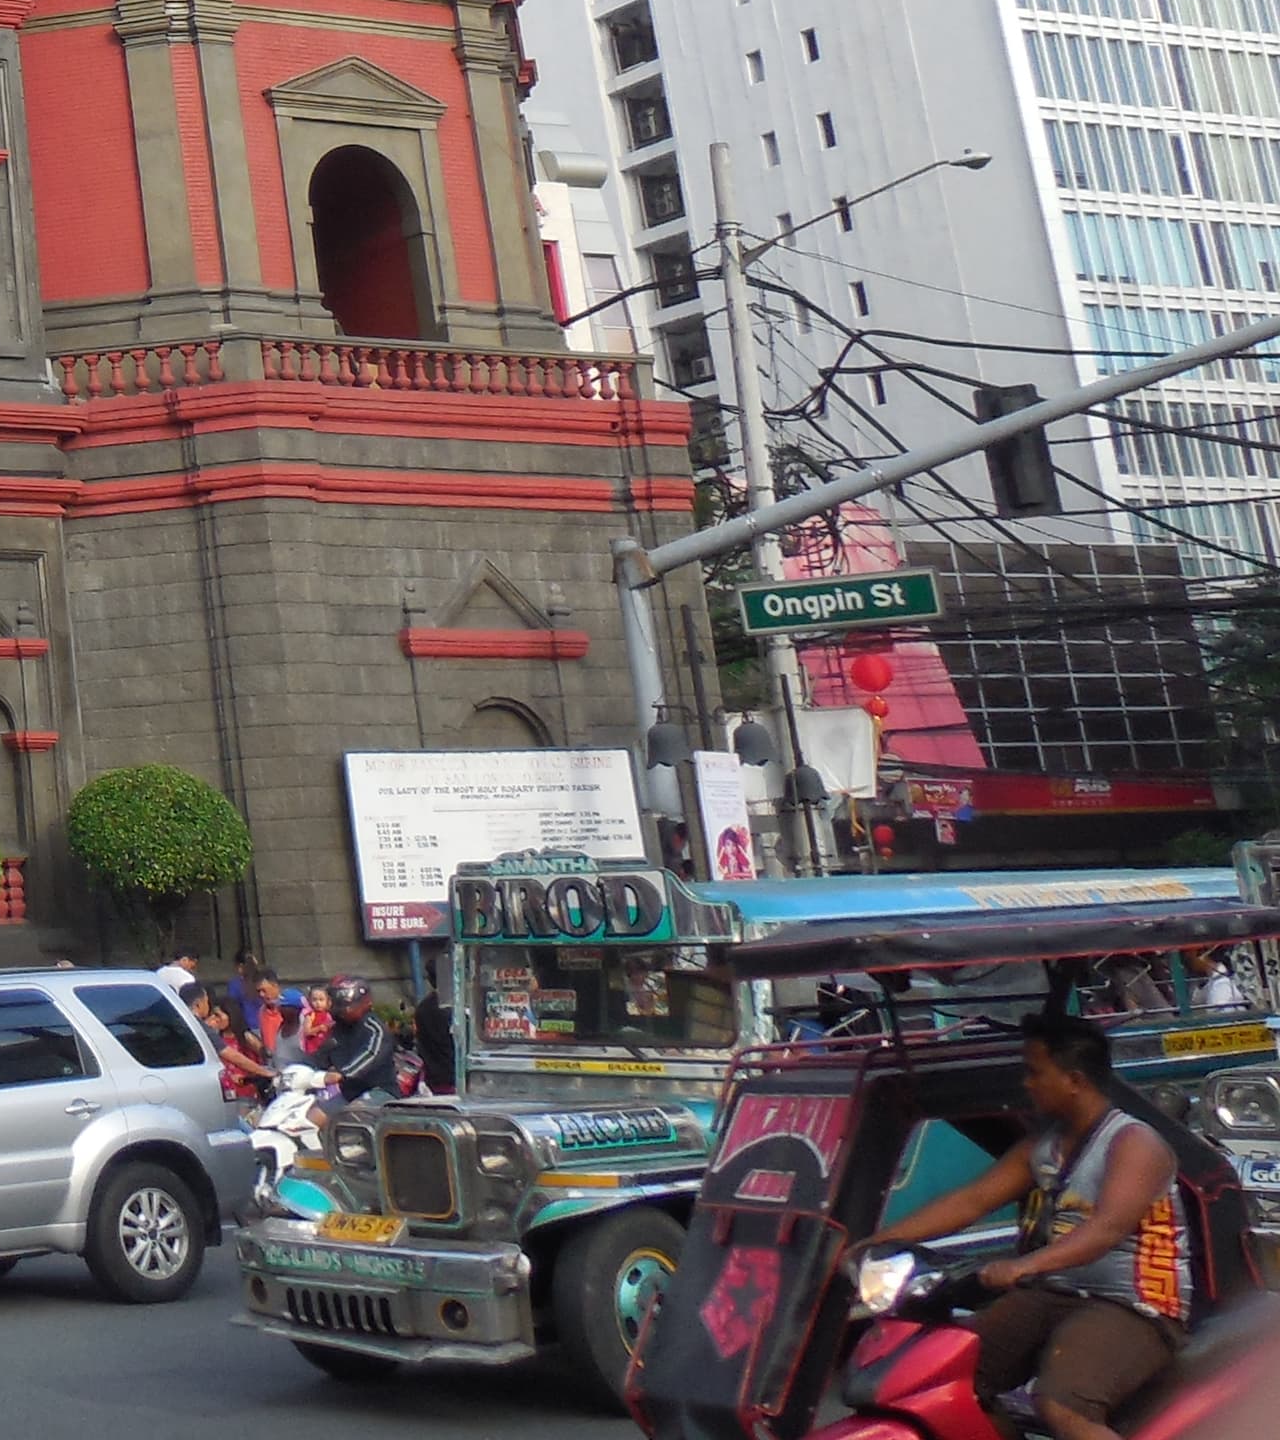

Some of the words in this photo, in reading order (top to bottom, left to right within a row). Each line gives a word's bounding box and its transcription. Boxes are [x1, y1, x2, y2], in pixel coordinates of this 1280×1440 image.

[763, 587, 864, 620] Ongpin
[871, 582, 905, 607] St
[488, 858, 599, 874] SAMANTHA
[372, 905, 405, 917] INSURE
[455, 876, 664, 938] BROD
[372, 919, 385, 930] TO
[386, 918, 398, 929] BE
[400, 917, 428, 929] SURE.
